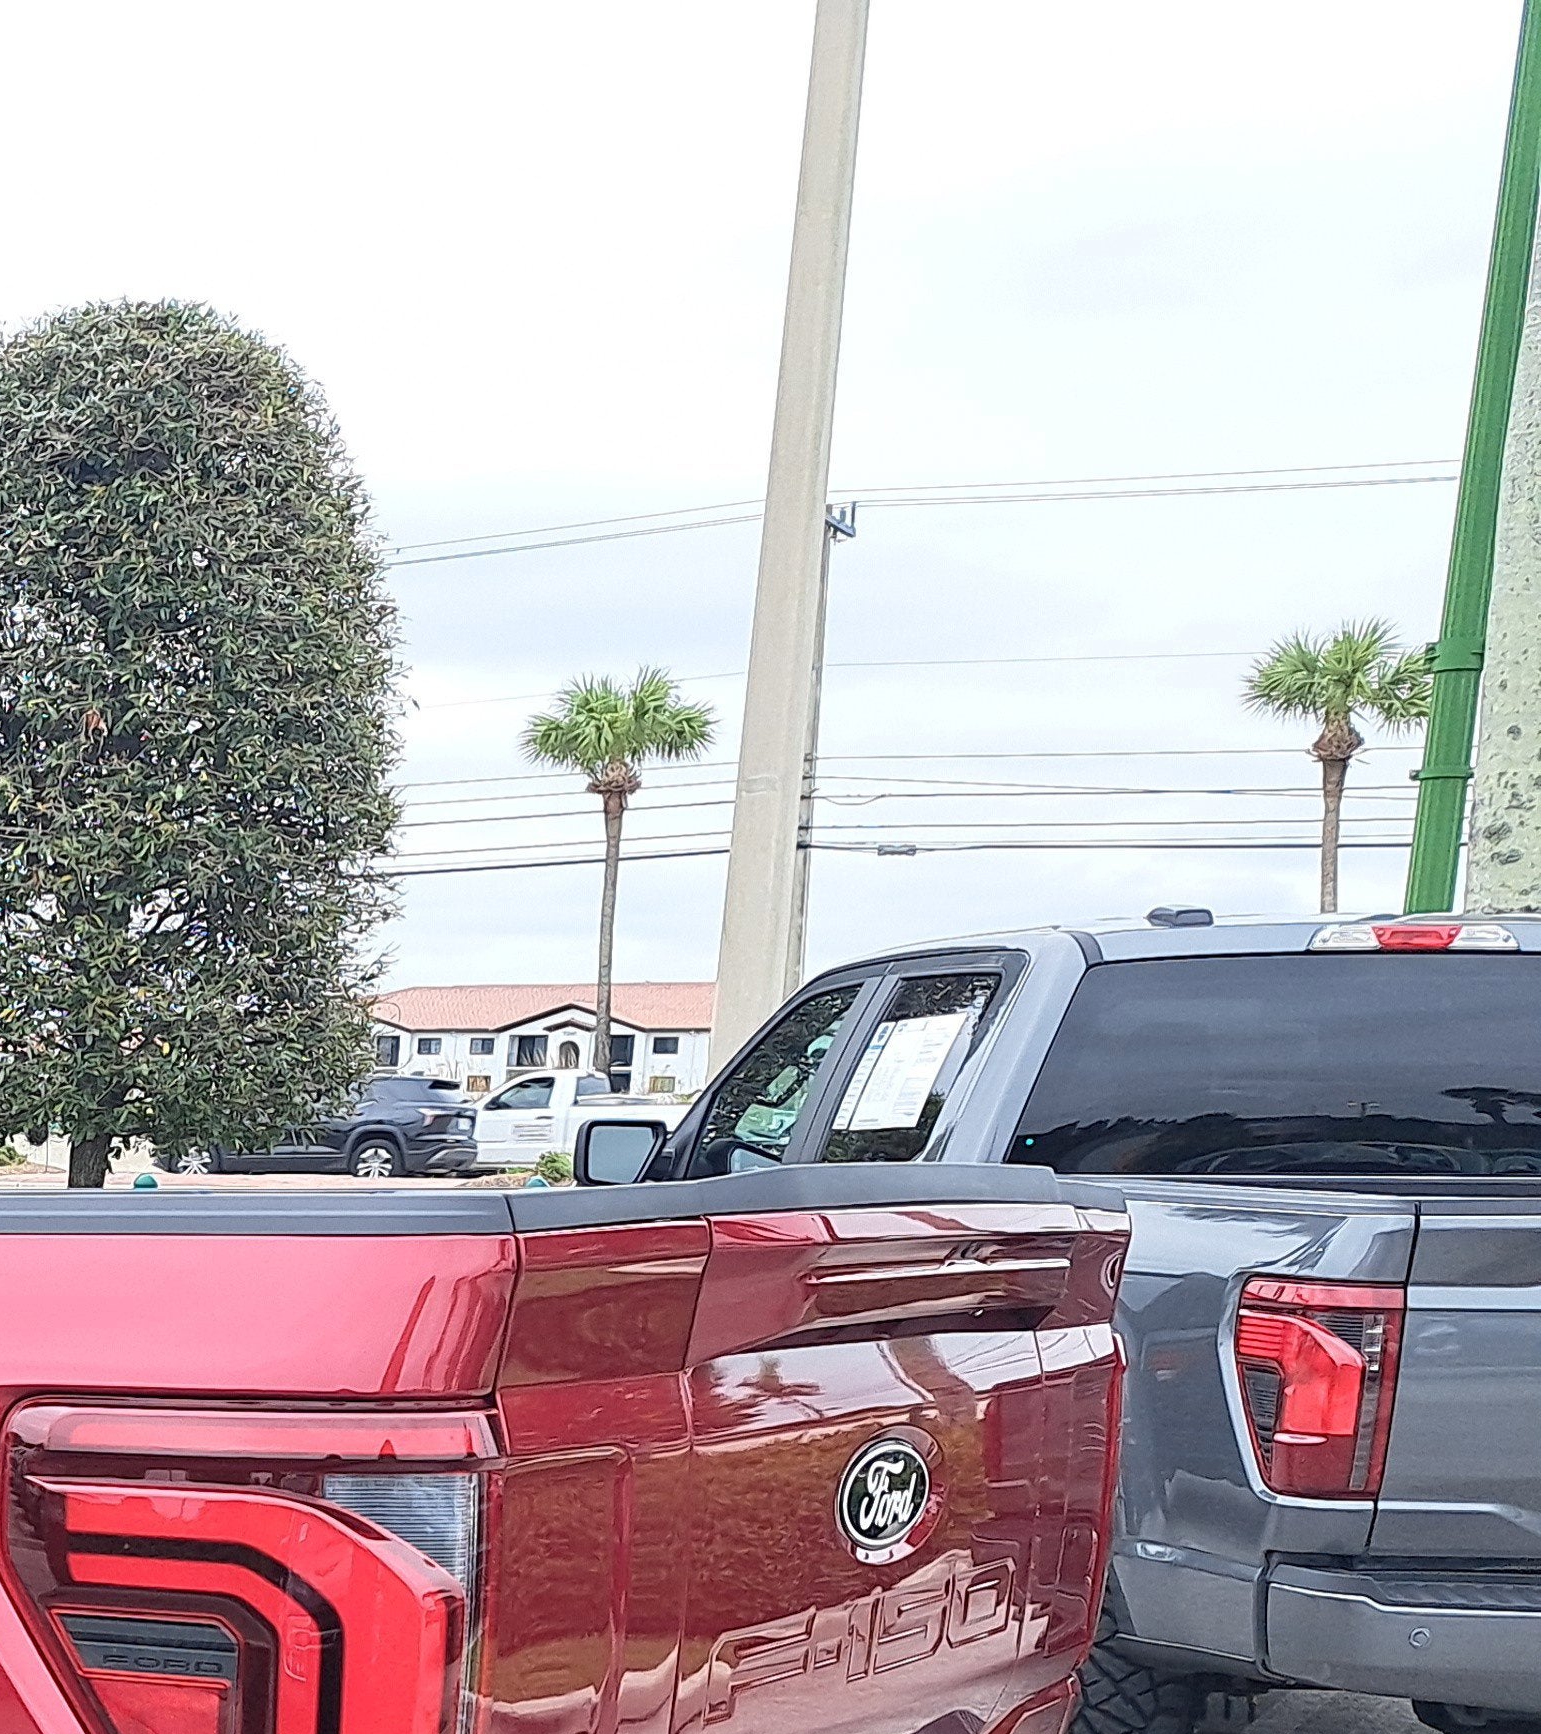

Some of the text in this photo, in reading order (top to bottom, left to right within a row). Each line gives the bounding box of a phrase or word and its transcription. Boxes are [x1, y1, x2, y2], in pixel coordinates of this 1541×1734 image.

[860, 1460, 916, 1530] Ford
[102, 1654, 224, 1674] FORD
[703, 1556, 1015, 1730] F-150
